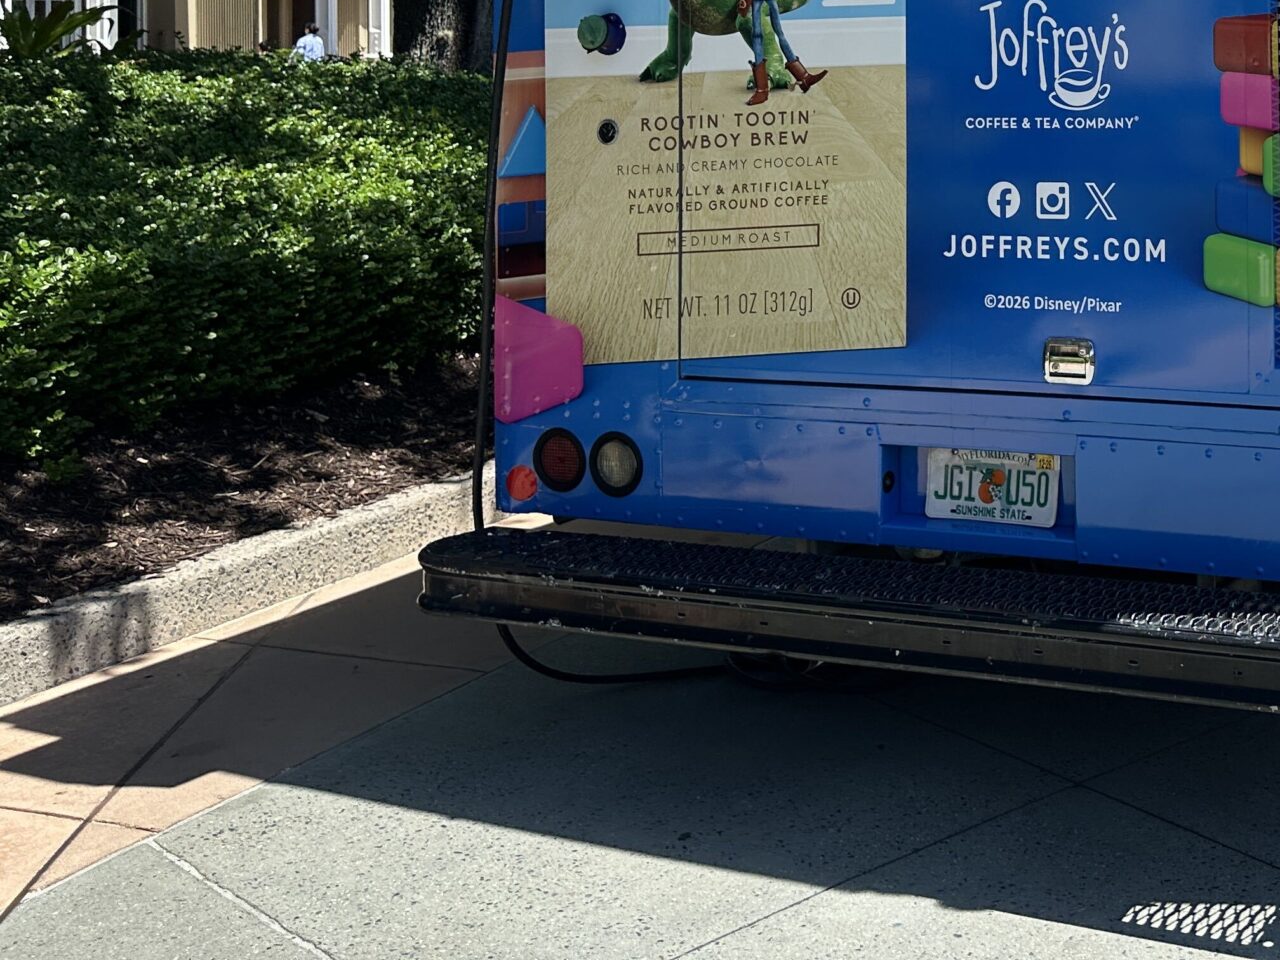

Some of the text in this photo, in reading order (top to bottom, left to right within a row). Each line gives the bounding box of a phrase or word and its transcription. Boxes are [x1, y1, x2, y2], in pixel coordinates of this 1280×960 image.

[641, 110, 816, 132] ROOTIN' TOOTIN'
[965, 118, 1018, 129] COFFEE
[1022, 118, 1031, 129] &
[1035, 117, 1060, 129] TEA
[649, 130, 808, 151] COWBOY BREW
[617, 163, 650, 176] RICH
[691, 159, 747, 172] CREAMY
[754, 154, 839, 169] CHOCOLATE
[716, 184, 725, 195] &
[732, 179, 829, 194] ARTIFICIALLY
[709, 197, 768, 210] GROUND
[774, 195, 829, 207] COFFEE
[667, 231, 791, 248] MEDIUM ROAST
[943, 234, 1166, 264] JOFFREYS.COM
[643, 297, 672, 319] NET
[680, 295, 707, 317] WT.
[714, 294, 730, 315] 11
[738, 292, 757, 314] OZ
[984, 293, 1122, 314] ©2026 Disney/Pixar
[955, 504, 1026, 520] SUNSHINE STATE
